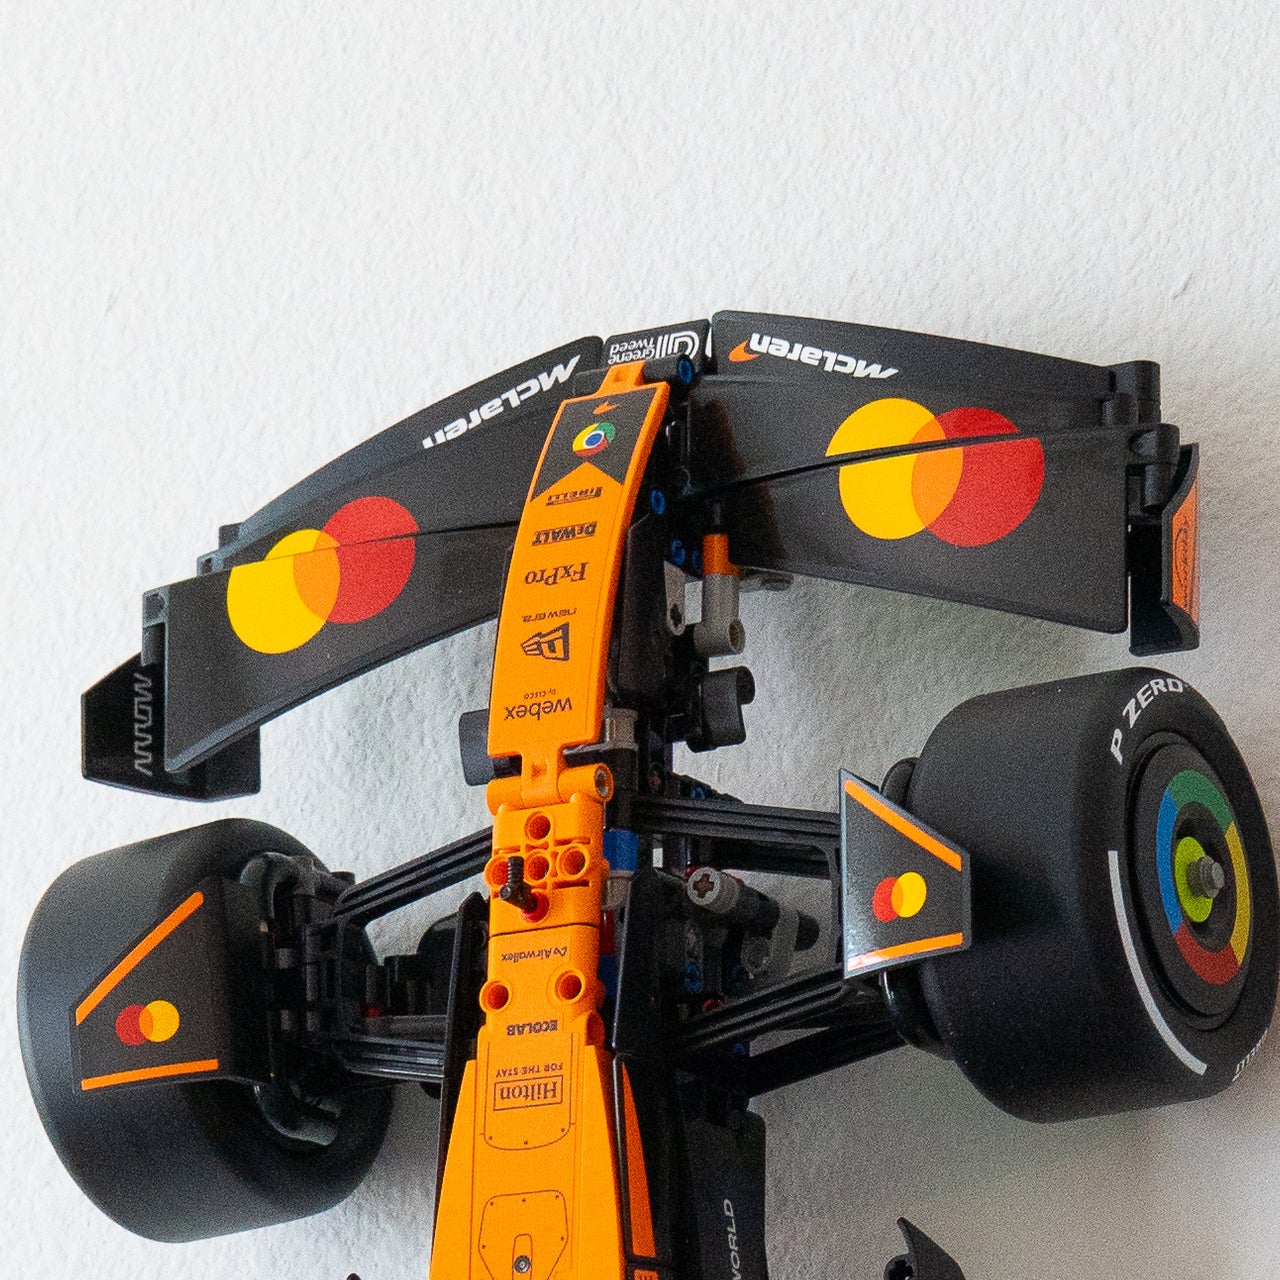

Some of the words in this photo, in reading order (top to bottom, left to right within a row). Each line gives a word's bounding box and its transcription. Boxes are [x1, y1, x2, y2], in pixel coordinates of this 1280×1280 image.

[609, 337, 655, 355] Tweed
[608, 348, 655, 365] Greene
[749, 332, 899, 379] McLaren
[422, 354, 581, 449] McLaren
[524, 561, 589, 586] FxPro
[504, 697, 573, 721] webex
[1110, 728, 1123, 765] P
[1122, 678, 1185, 729] ZERO
[501, 948, 552, 964] Airwallex
[506, 1019, 558, 1037] ECOLAB
[496, 1068, 520, 1078] STAY
[521, 1066, 541, 1076] THE
[544, 1062, 564, 1073] FOR
[499, 1080, 558, 1102] Hilton
